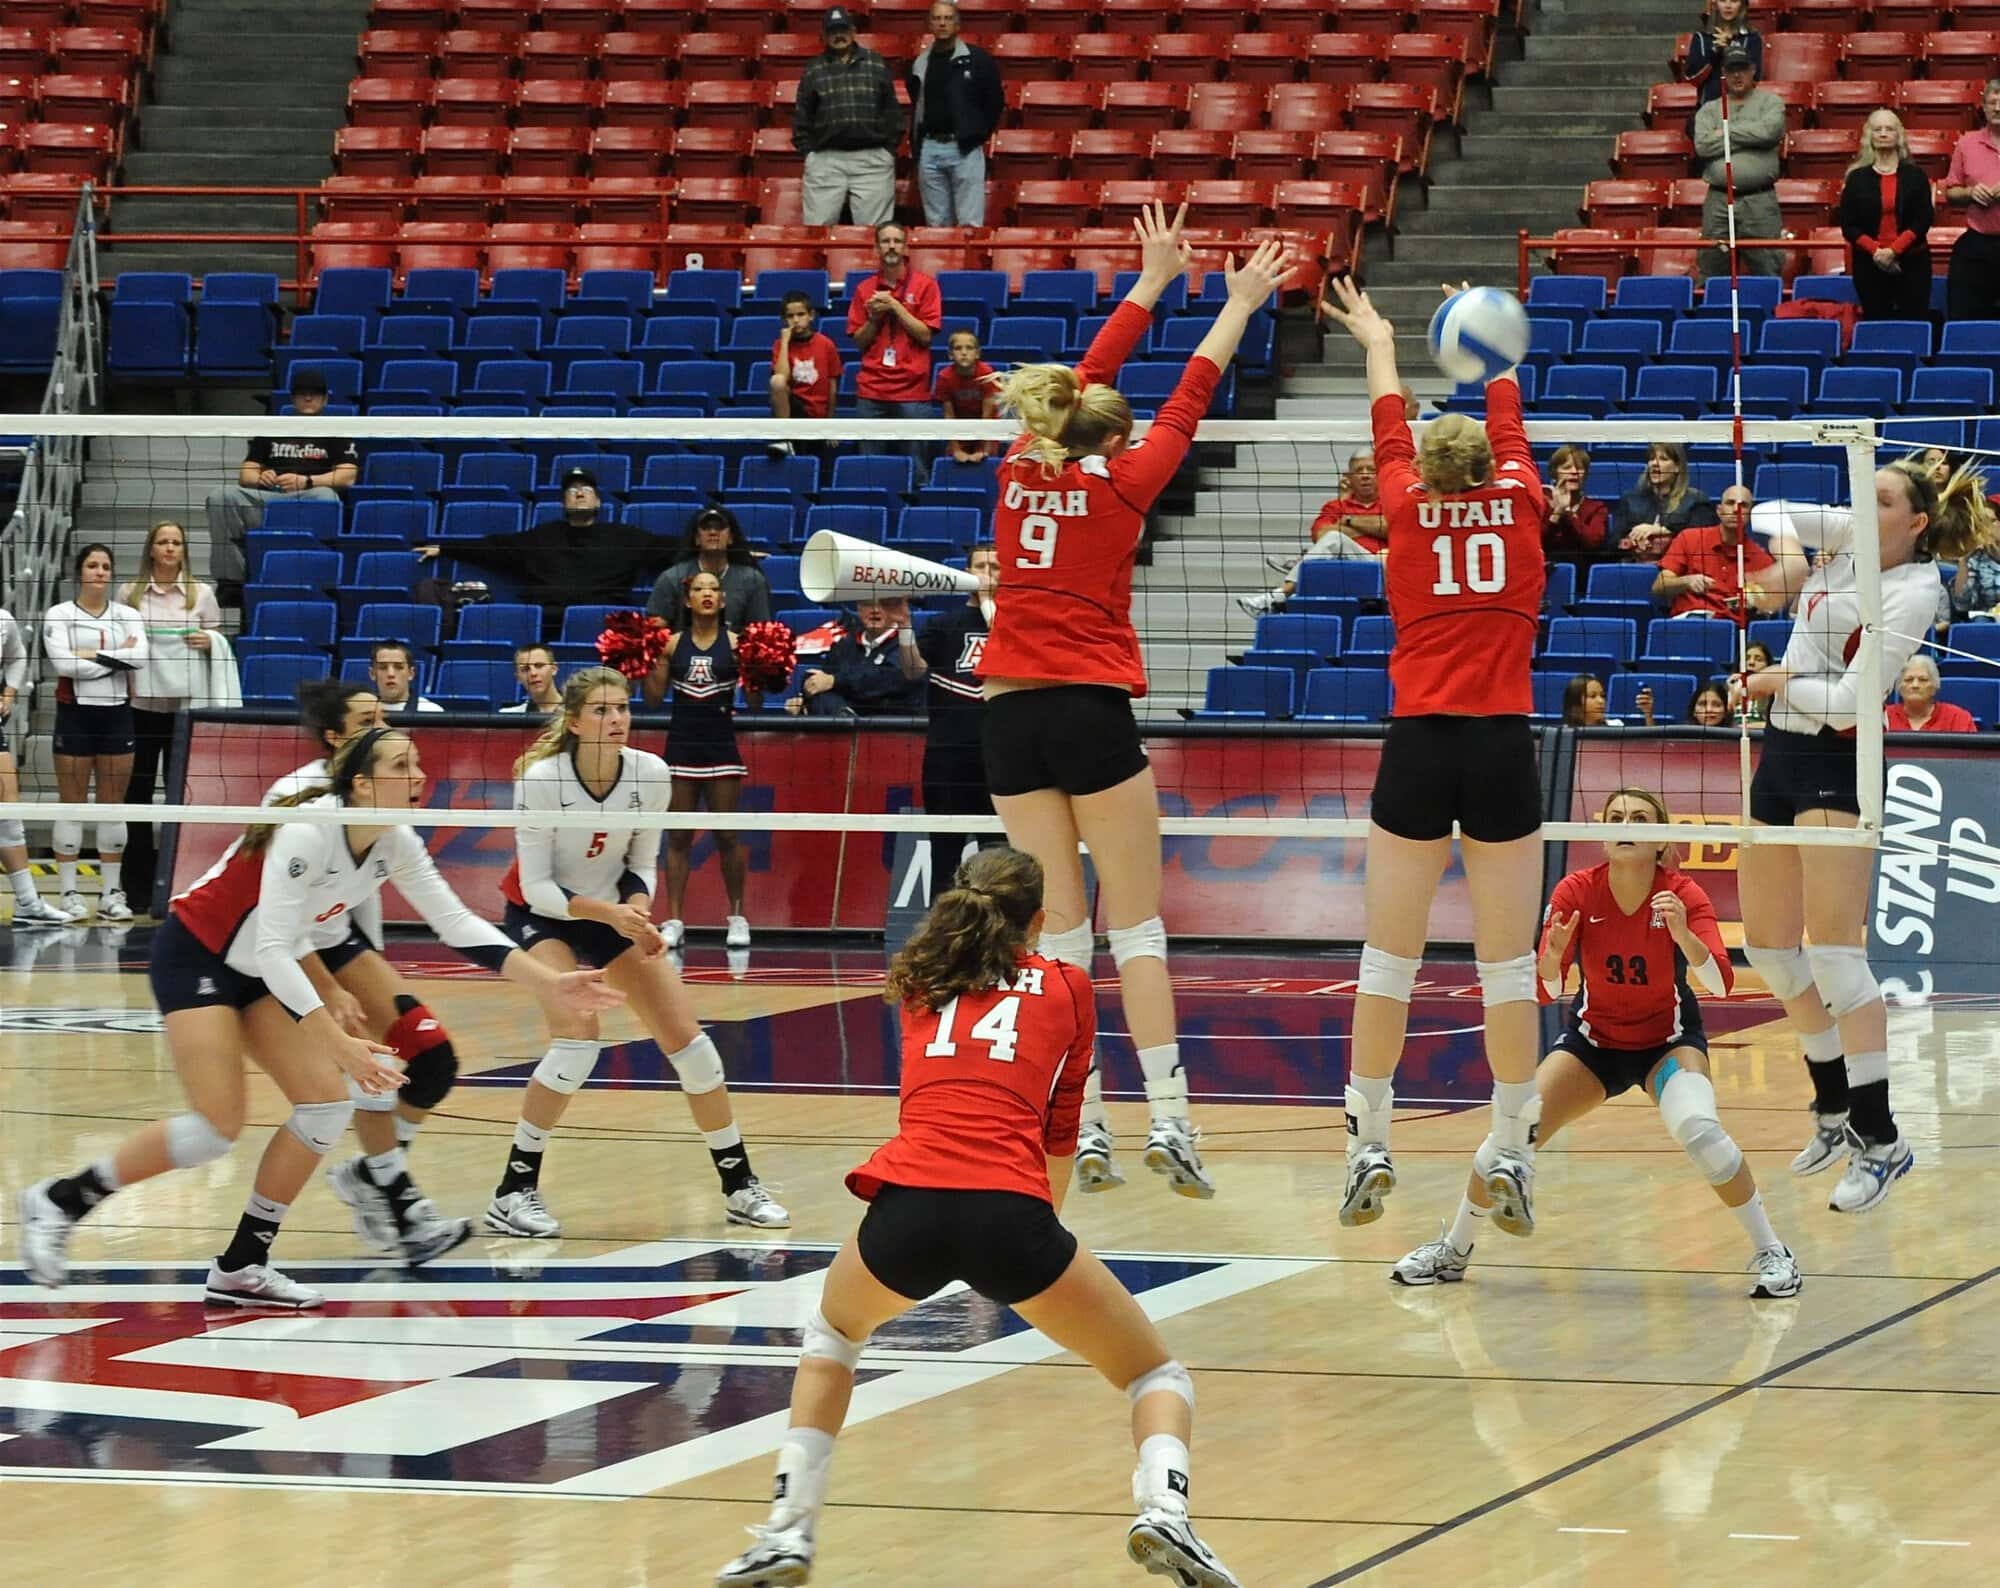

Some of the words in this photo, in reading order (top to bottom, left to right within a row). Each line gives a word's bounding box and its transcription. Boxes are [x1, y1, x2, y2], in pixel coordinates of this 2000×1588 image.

[1004, 481, 1088, 516] UTAH
[1417, 499, 1515, 528] UTAH
[1016, 514, 1058, 569] 9
[1432, 533, 1506, 595] 10
[586, 832, 608, 858] 5
[1875, 764, 1943, 955] STAND
[1606, 954, 1649, 986] 33
[925, 996, 1021, 1062] 14
